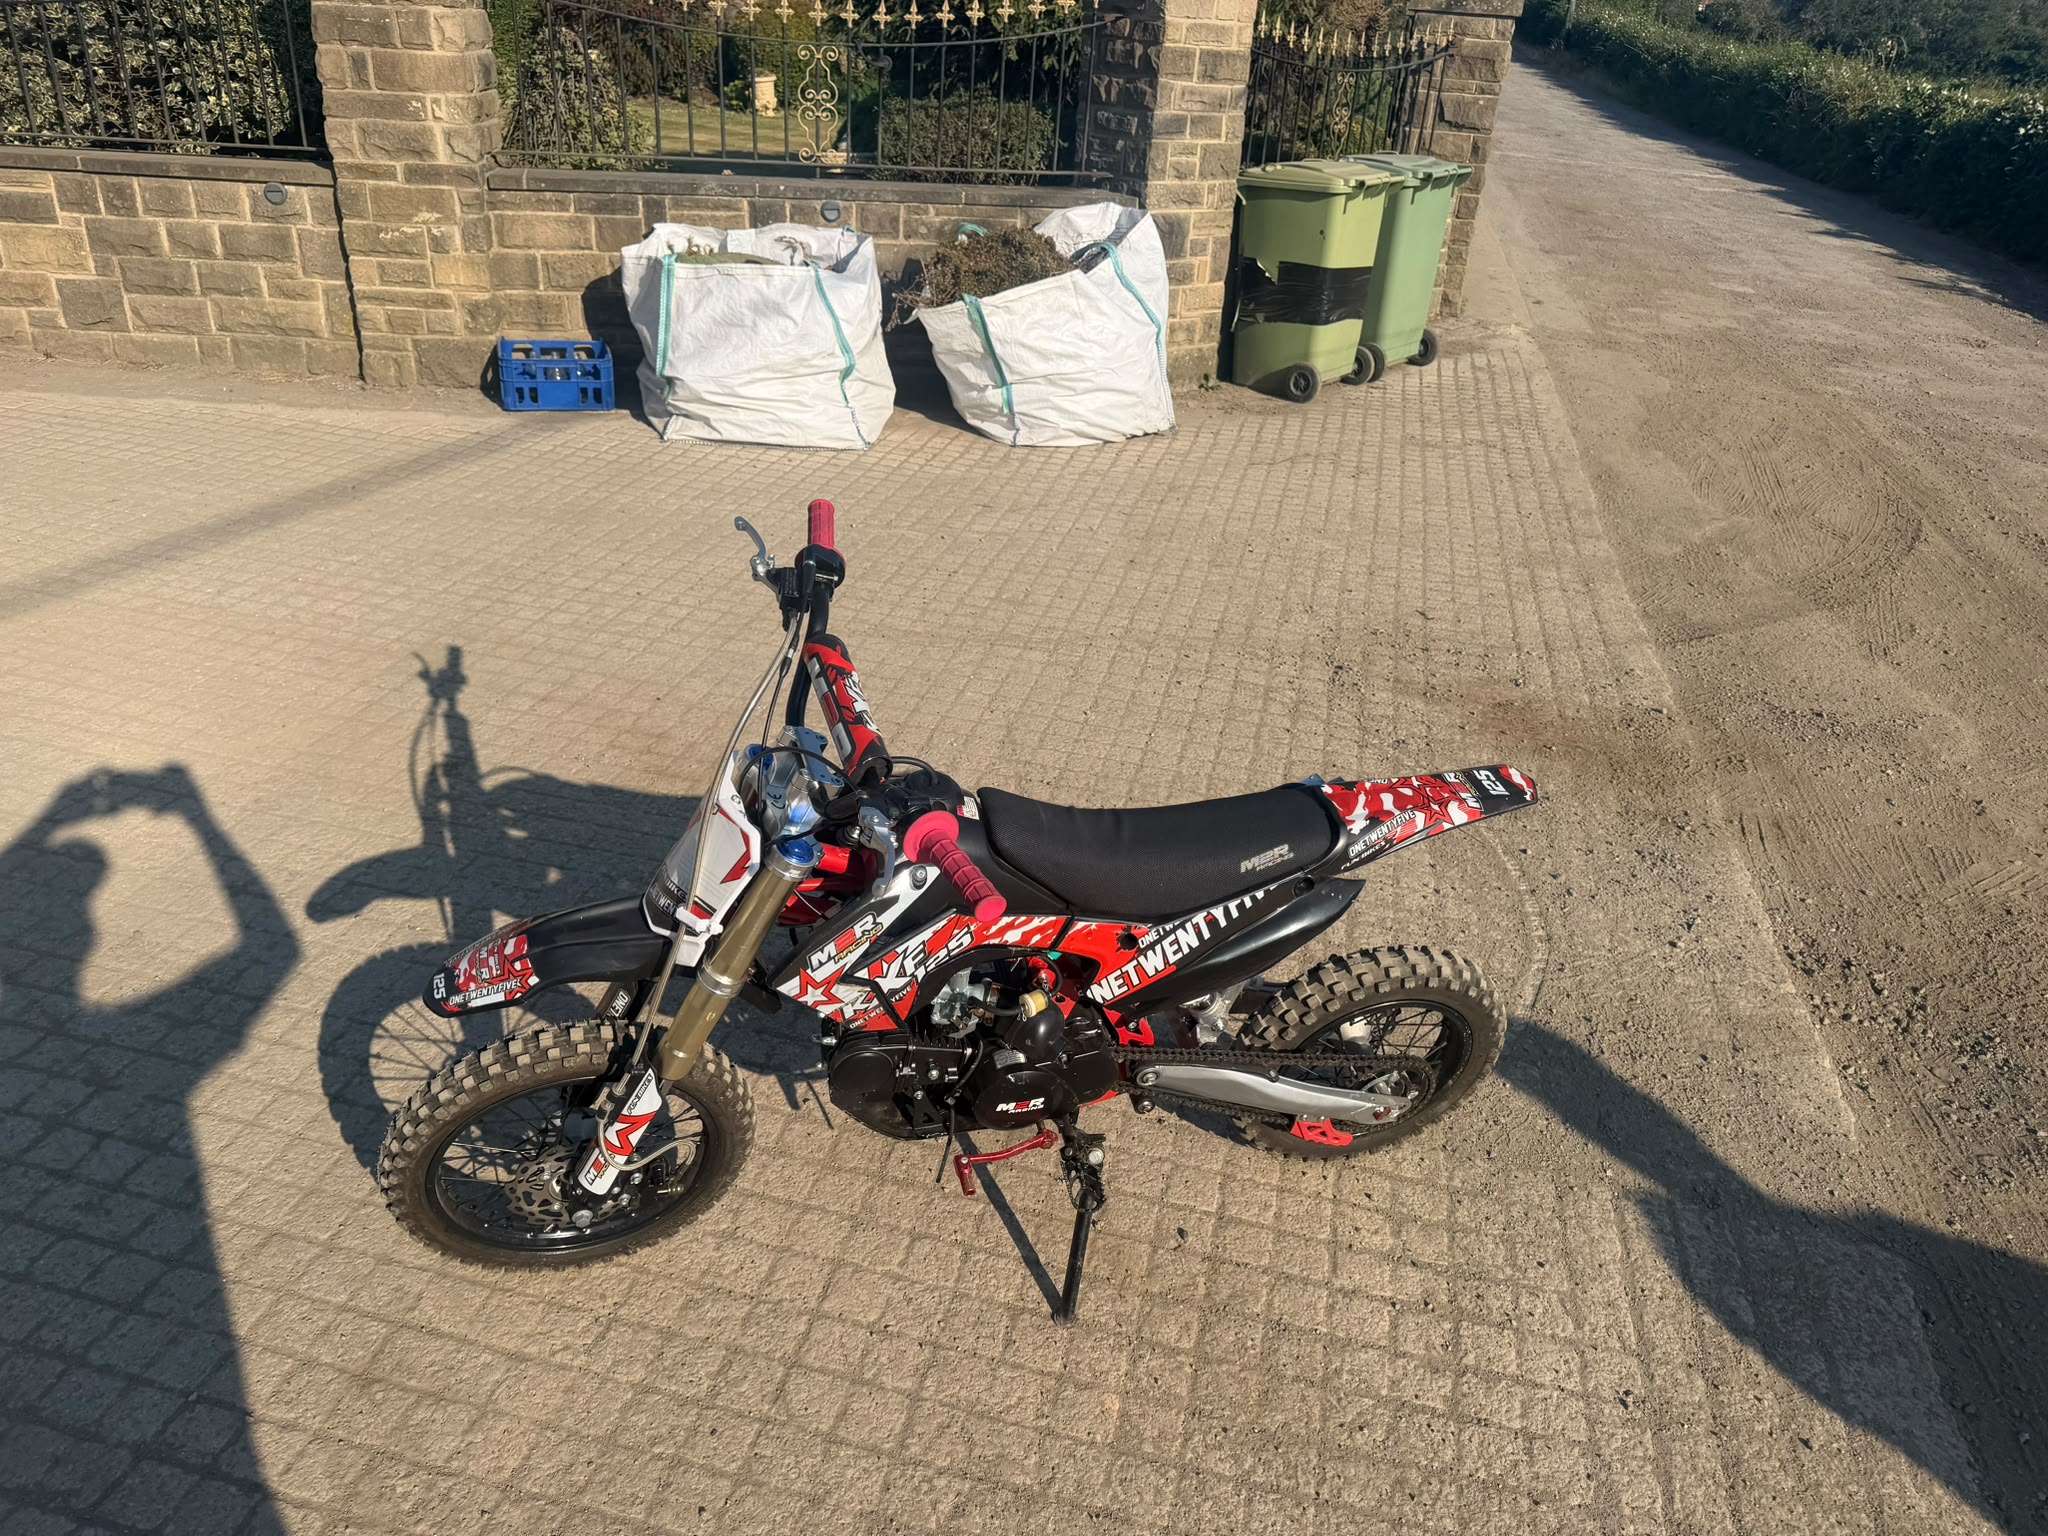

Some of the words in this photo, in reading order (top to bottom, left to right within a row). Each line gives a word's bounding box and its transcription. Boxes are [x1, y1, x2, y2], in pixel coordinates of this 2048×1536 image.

[1472, 769, 1510, 796] 125
[1349, 809, 1415, 857] ONETWENTYFIVE
[833, 925, 883, 963] RACING
[914, 923, 974, 984] 125
[433, 973, 447, 1000] 125
[450, 980, 518, 1006] ONETWENTYFIVE
[995, 1097, 1045, 1111] M2R
